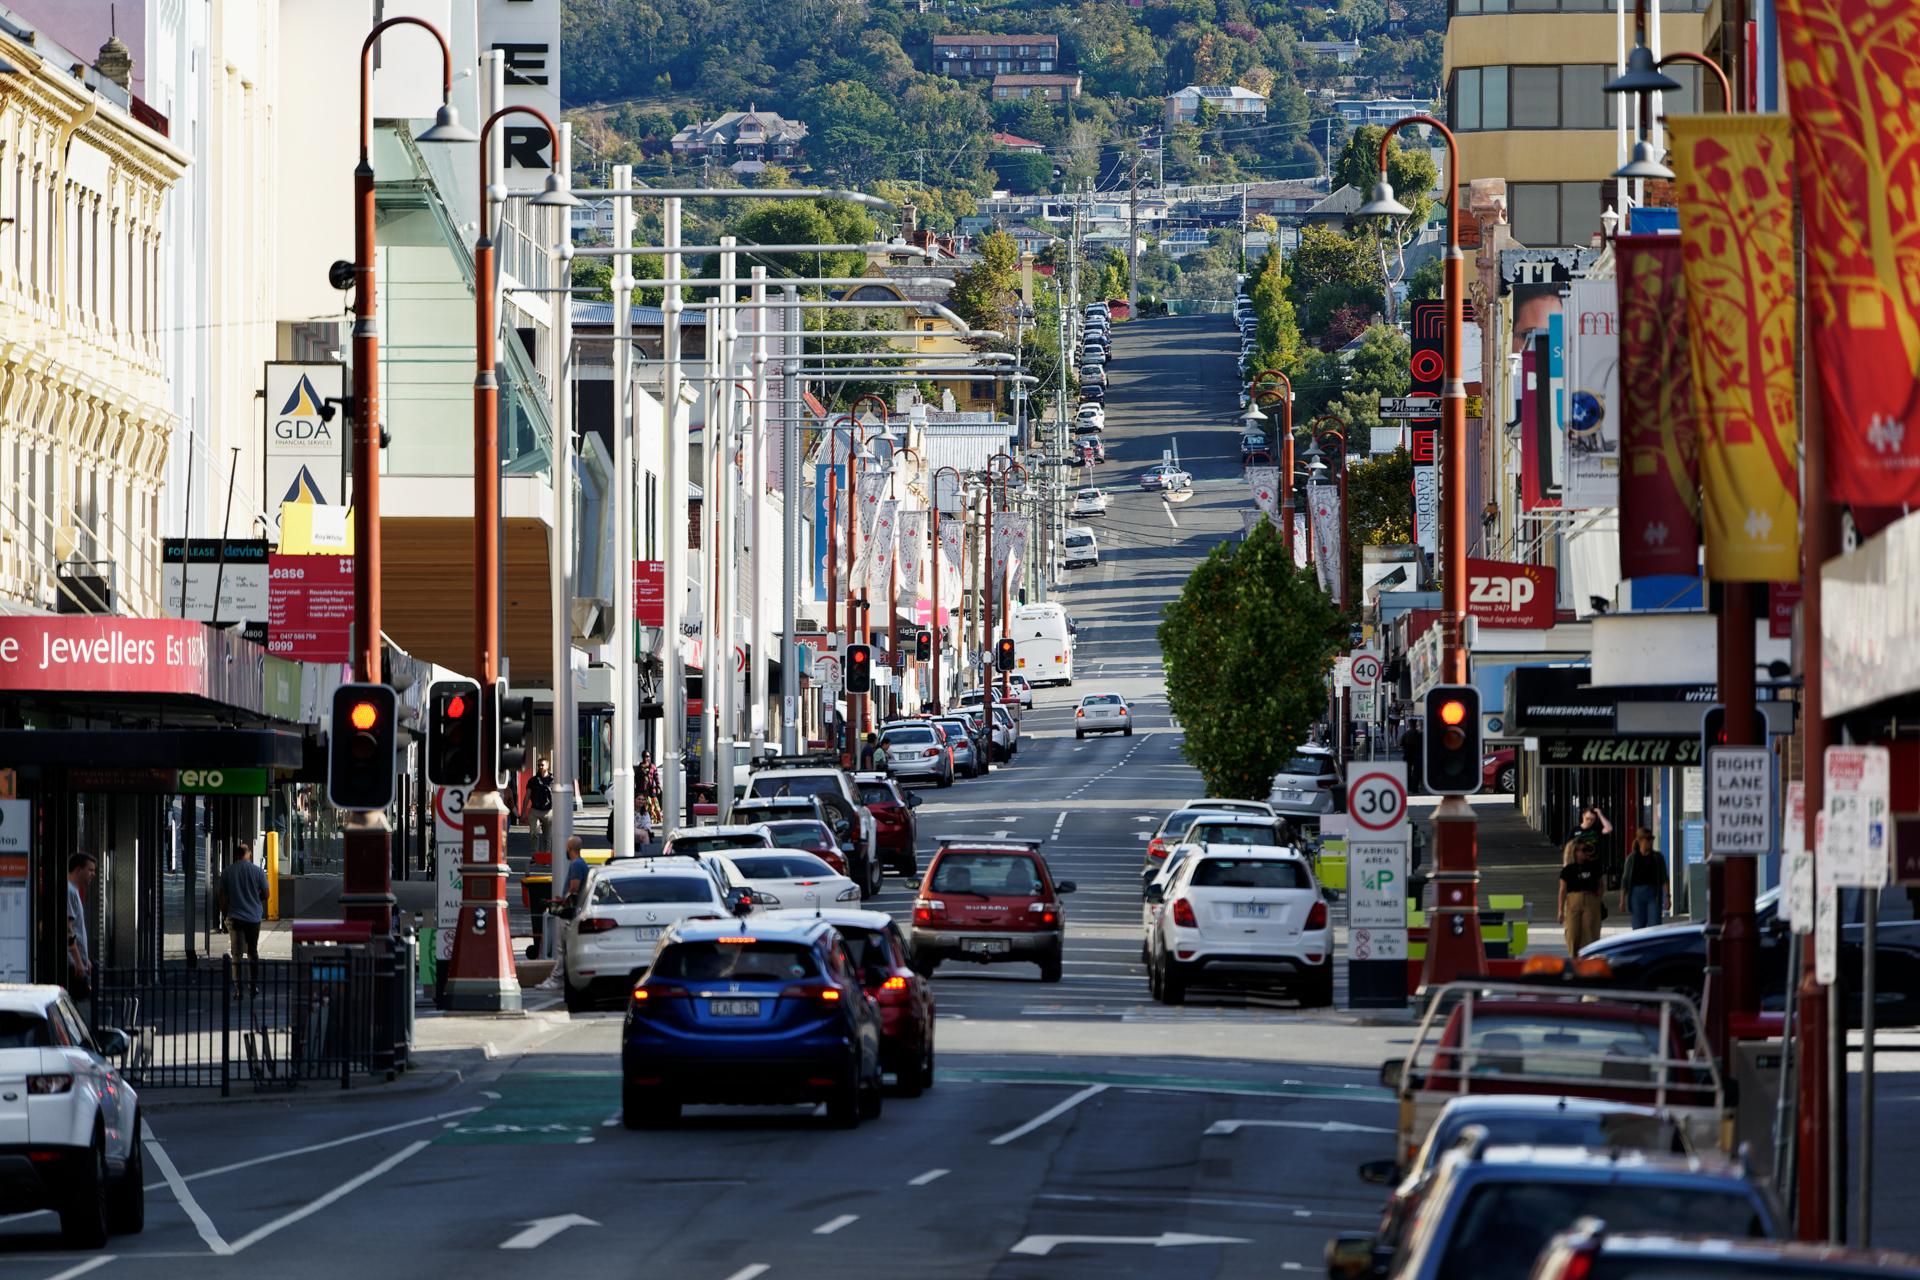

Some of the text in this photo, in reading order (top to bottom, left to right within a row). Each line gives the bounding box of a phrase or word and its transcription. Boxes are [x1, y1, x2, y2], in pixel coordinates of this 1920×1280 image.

[275, 420, 331, 439] GDA
[1417, 471, 1431, 532] GARDEN
[189, 547, 215, 556] LEASE
[270, 567, 304, 580] ease
[1469, 577, 1534, 612] zap
[1494, 604, 1509, 612] 24/7
[39, 631, 155, 669] Jewellers
[166, 634, 184, 666] Est
[1356, 664, 1377, 677] 40
[1582, 739, 1702, 762] HEALTH ST
[1717, 757, 1764, 772] RIGHT
[1718, 777, 1763, 791] LANE
[1360, 788, 1397, 814] 30
[1718, 795, 1763, 809] MUST
[1720, 813, 1764, 827] TURN
[1716, 831, 1764, 846] RIGHT
